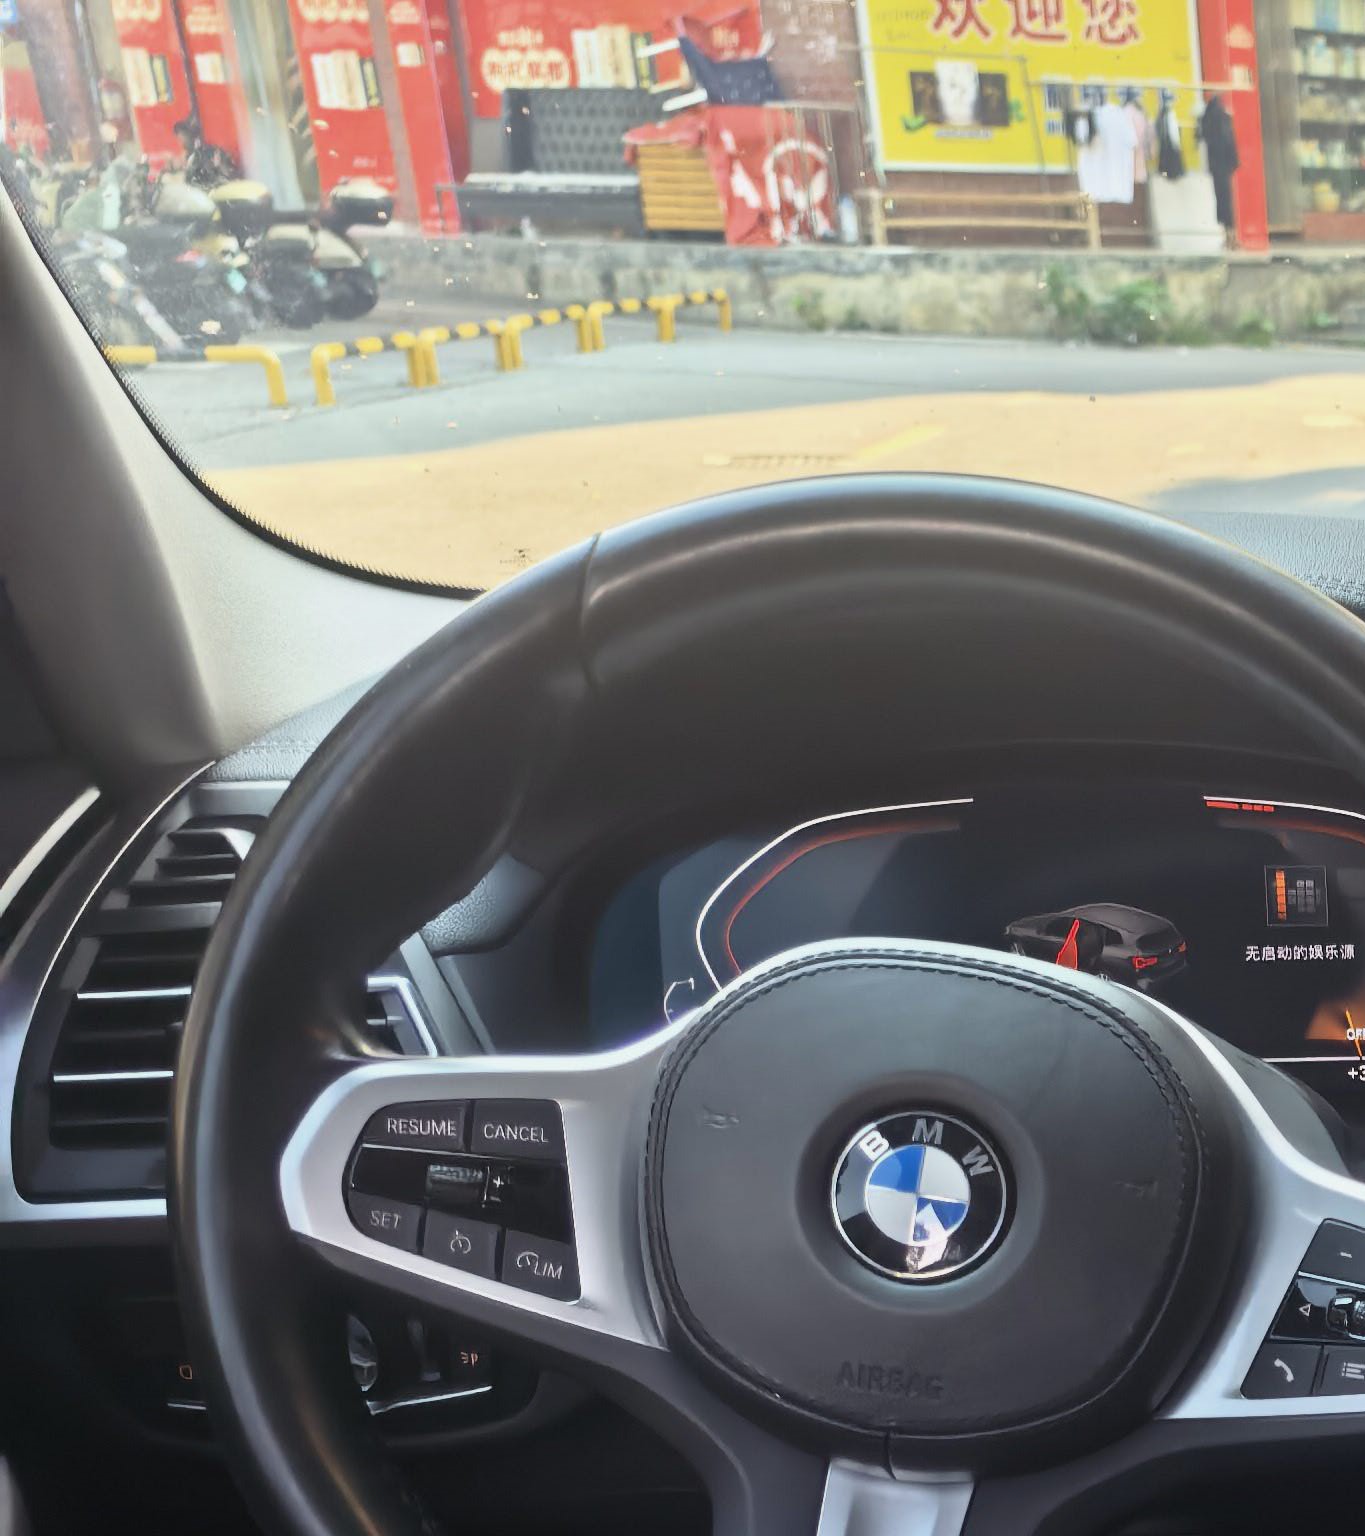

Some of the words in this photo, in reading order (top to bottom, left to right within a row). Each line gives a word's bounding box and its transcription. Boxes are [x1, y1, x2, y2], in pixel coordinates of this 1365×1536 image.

[1245, 944, 1355, 961] 无启动的娱乐源
[387, 1117, 457, 1138] RESUME
[483, 1123, 549, 1143] CANCEL
[859, 1118, 993, 1177] BMW
[370, 1209, 400, 1229] SET
[534, 1263, 562, 1279] LIM
